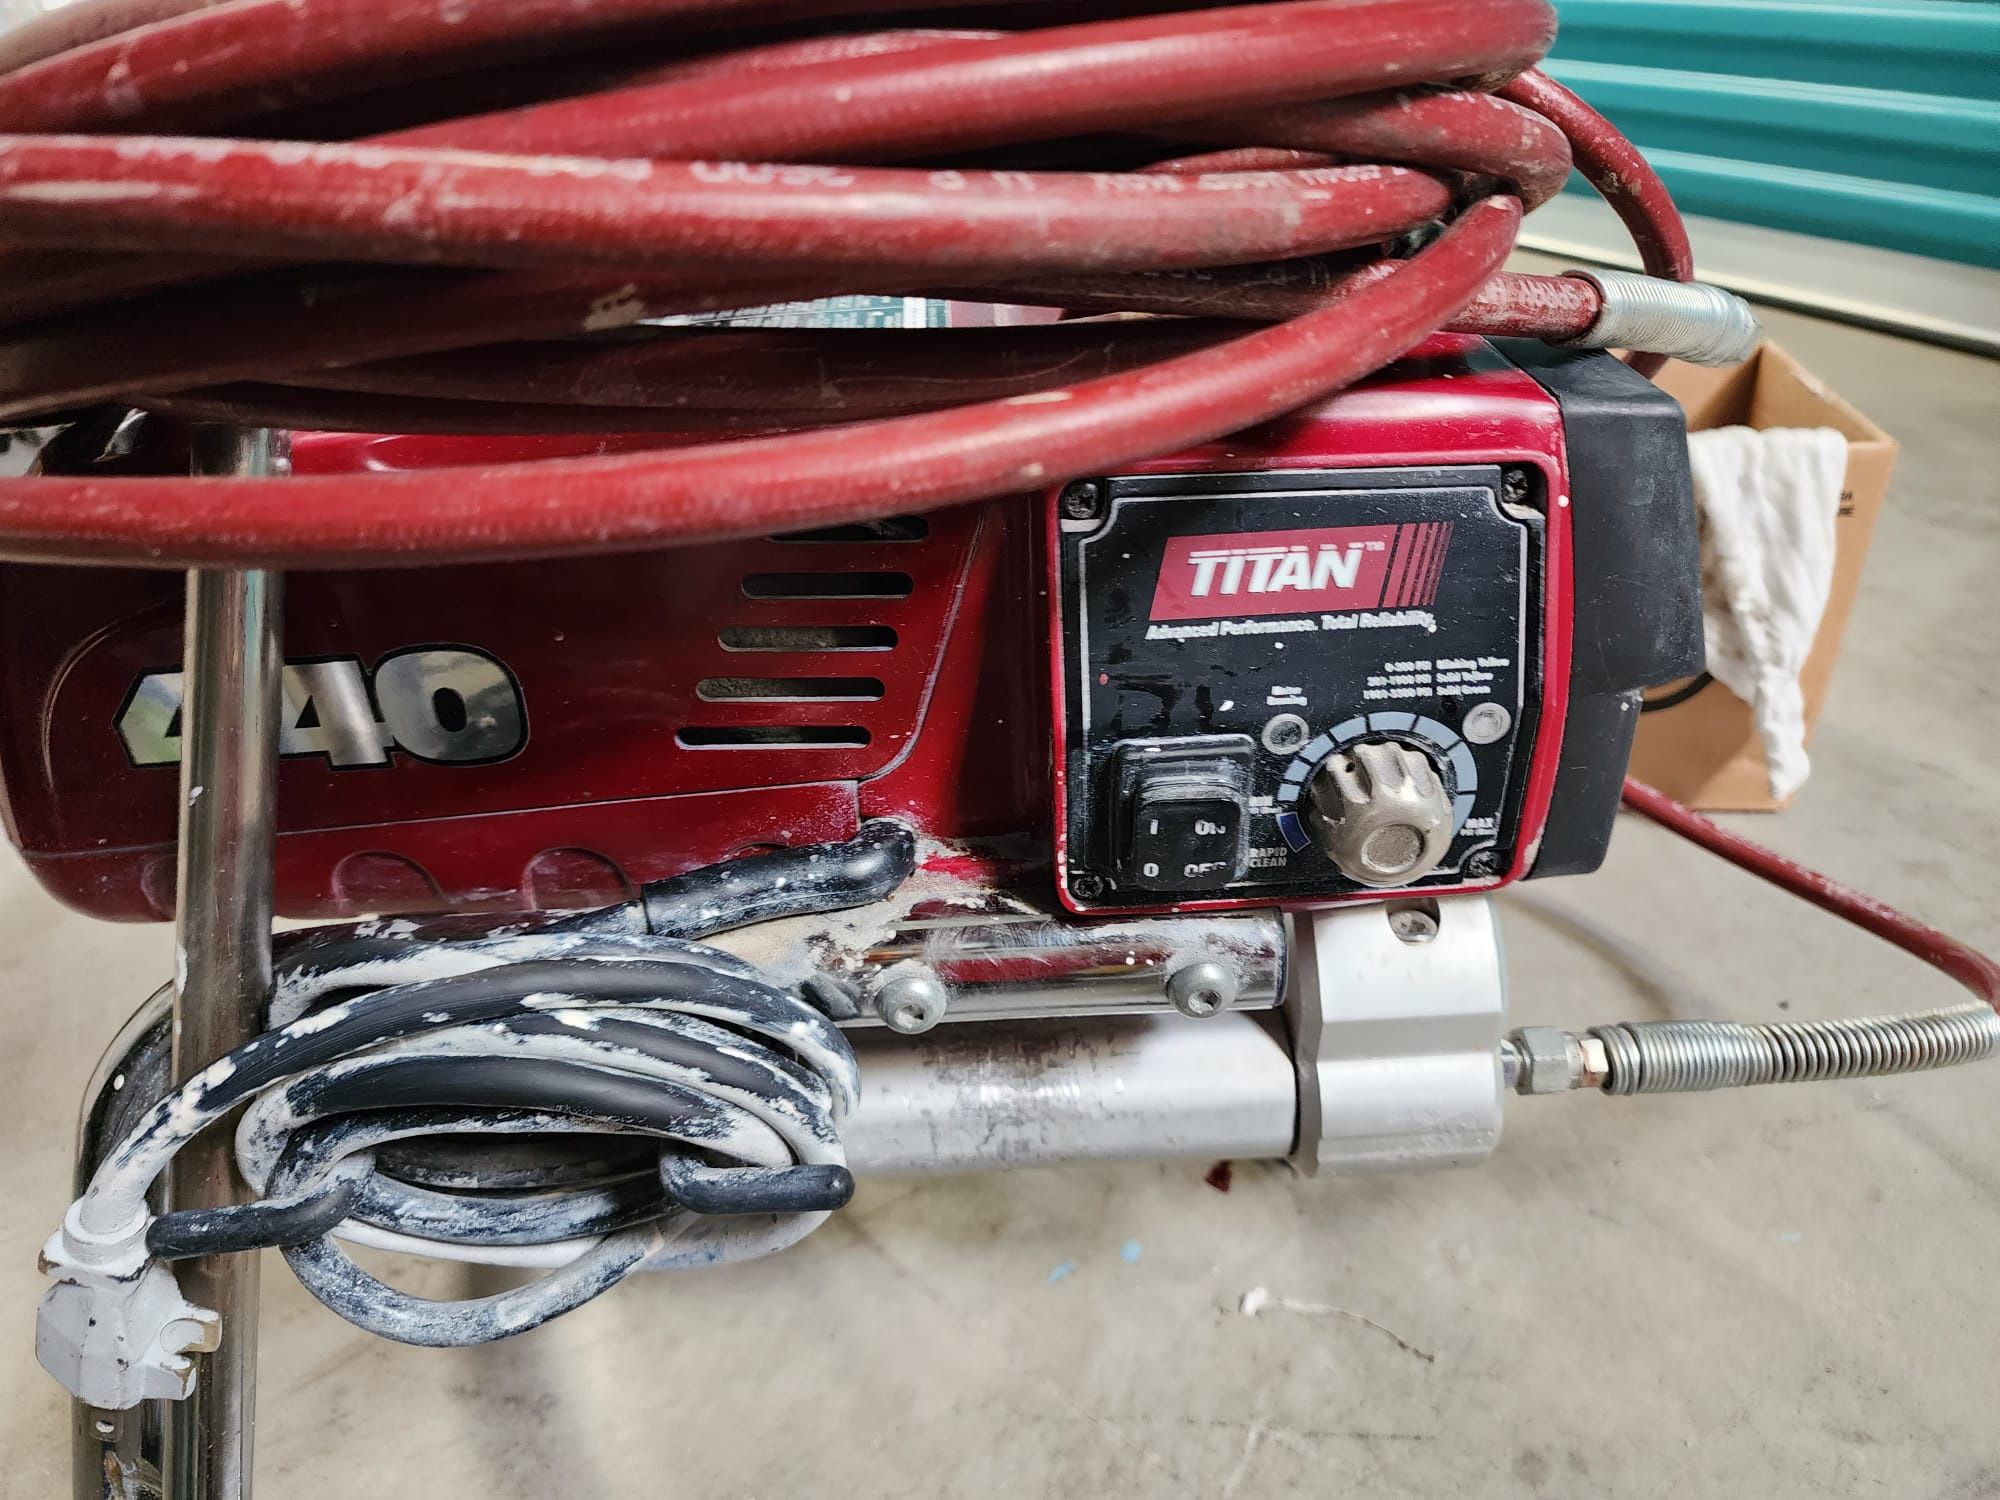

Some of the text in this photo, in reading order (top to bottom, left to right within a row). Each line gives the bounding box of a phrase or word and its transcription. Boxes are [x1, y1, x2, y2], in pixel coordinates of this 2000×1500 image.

[1188, 542, 1363, 596] TITAN
[1321, 613, 1360, 630] Total
[1249, 847, 1288, 858] RAPID
[1249, 857, 1287, 868] CLEAN
